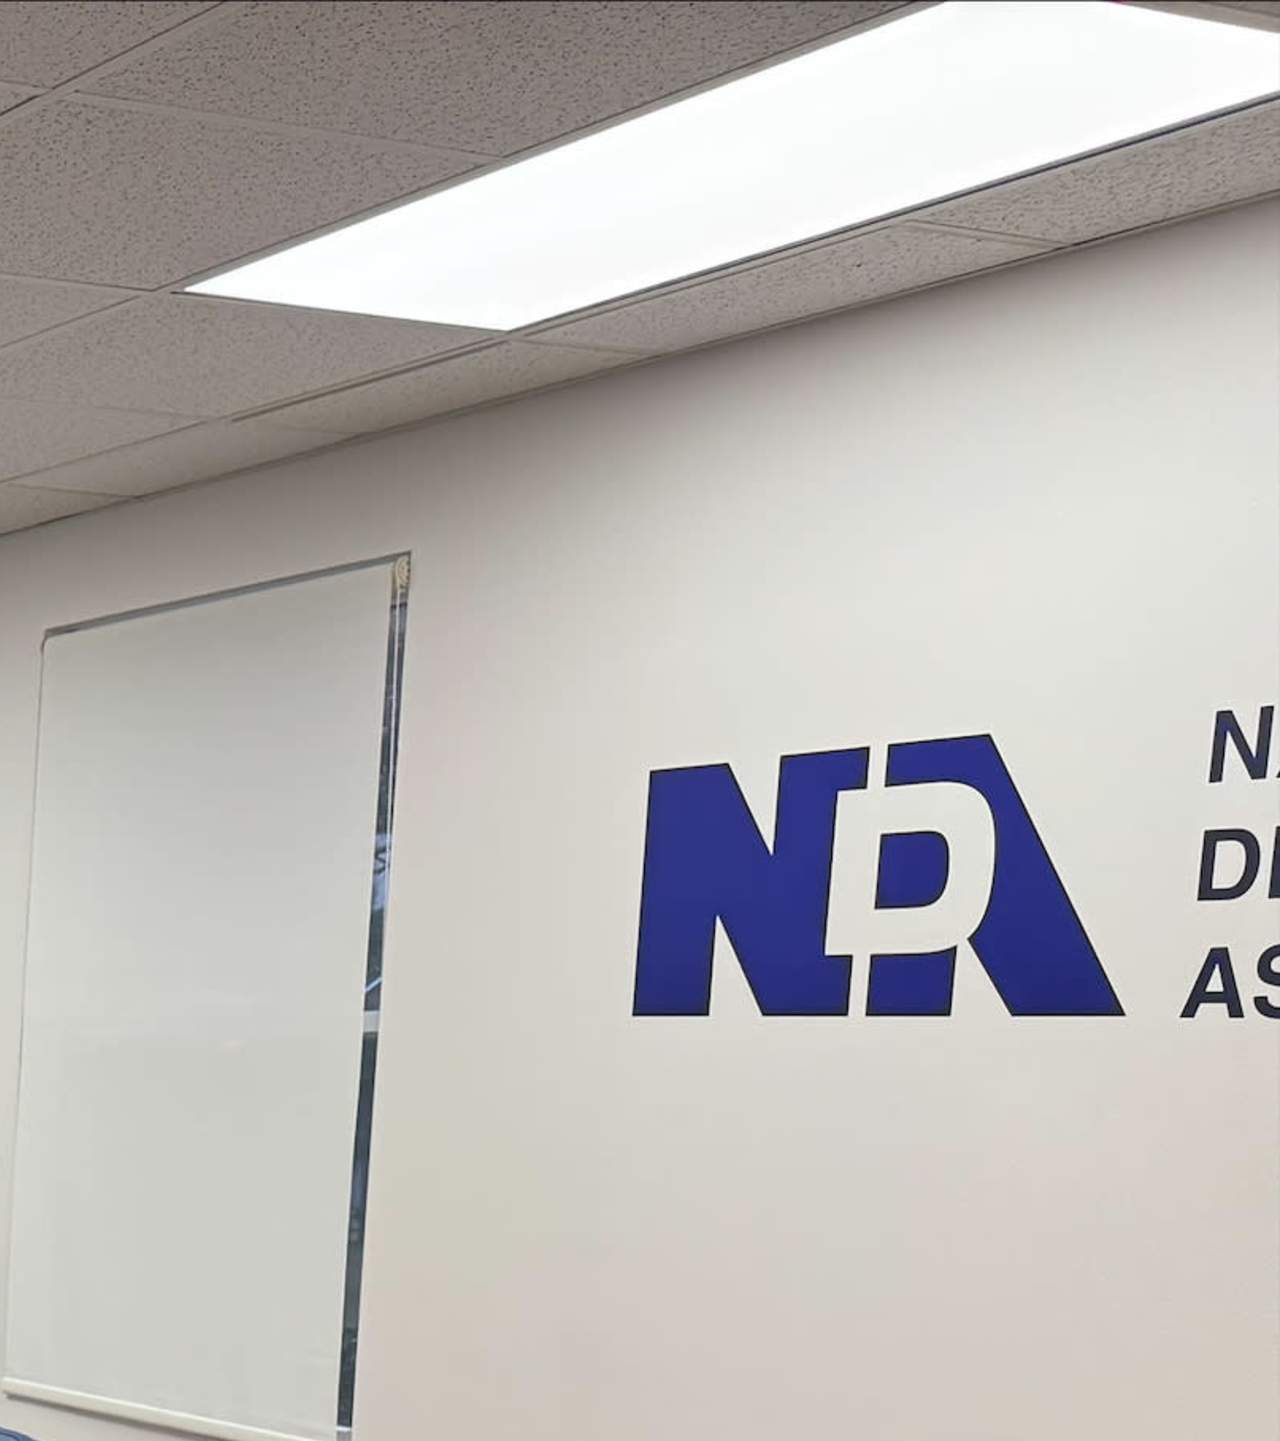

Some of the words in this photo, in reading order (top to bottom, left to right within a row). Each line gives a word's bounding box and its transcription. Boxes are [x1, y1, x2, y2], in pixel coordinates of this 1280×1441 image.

[1209, 705, 1280, 782] N
[633, 734, 1125, 1016] NDA
[1197, 826, 1280, 901] D
